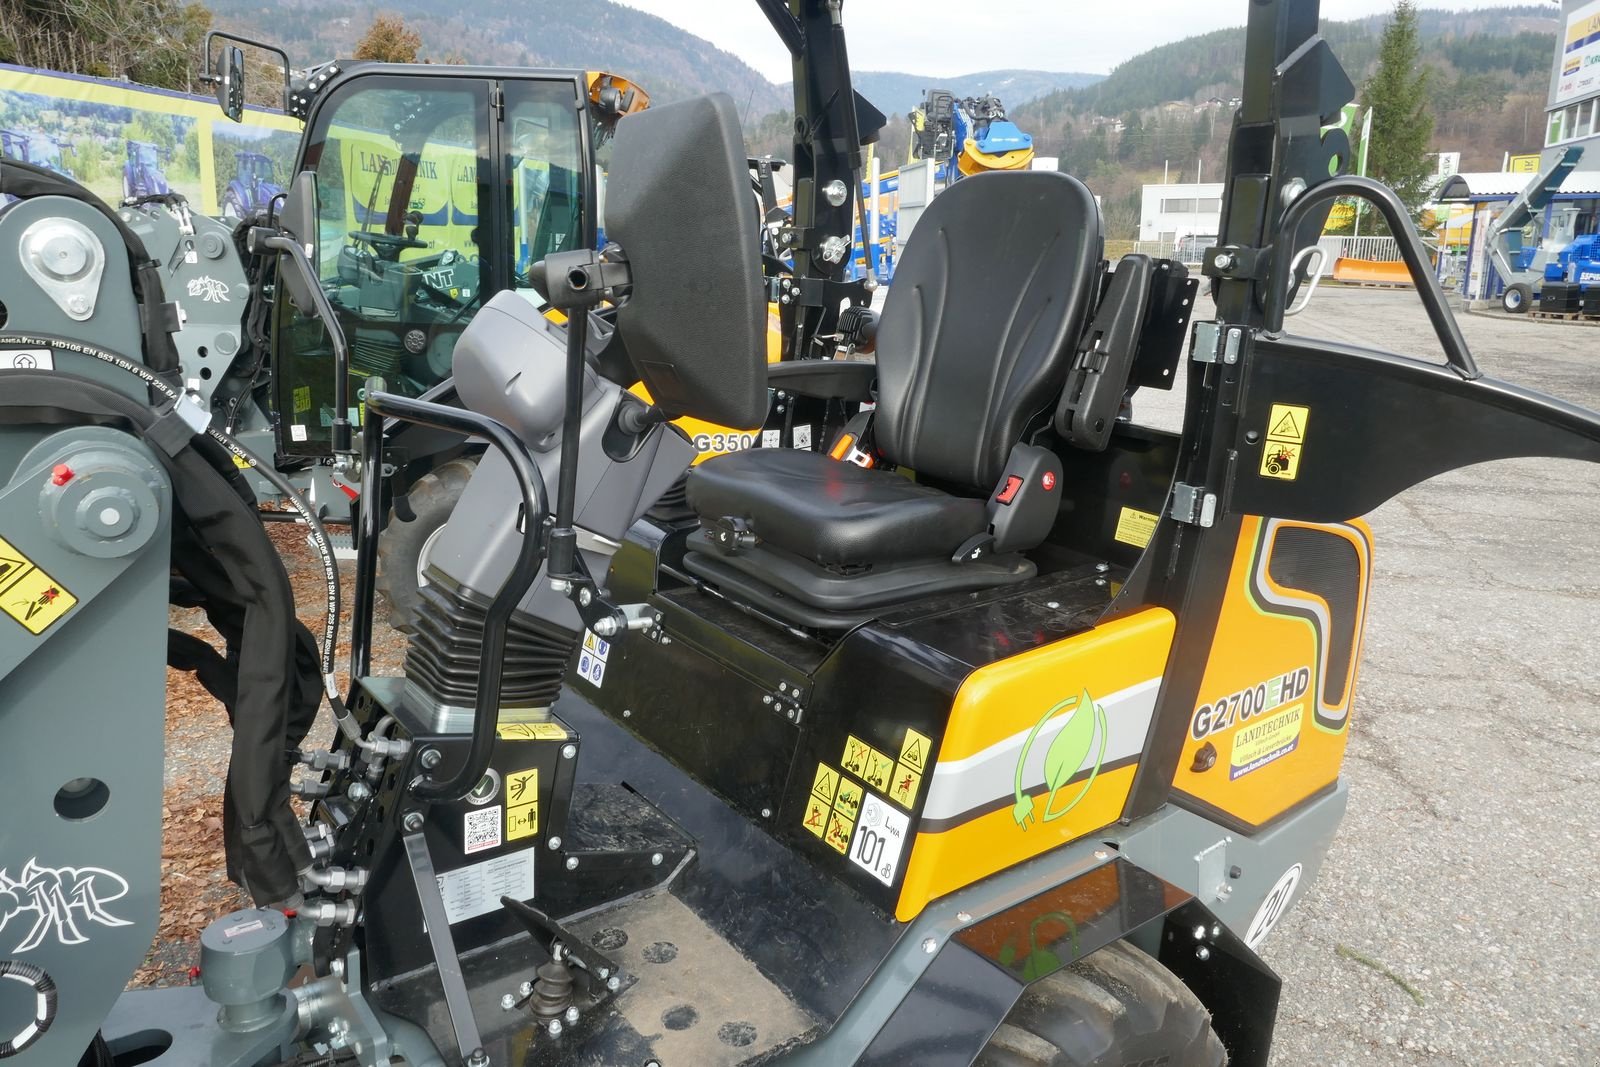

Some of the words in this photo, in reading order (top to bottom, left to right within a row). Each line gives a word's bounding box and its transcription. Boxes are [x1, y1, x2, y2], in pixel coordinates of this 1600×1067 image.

[51, 340, 81, 352] HD106
[83, 347, 97, 356] EN
[97, 351, 114, 362] 853
[115, 358, 133, 371] 1SN
[139, 370, 153, 381] WP
[152, 379, 168, 392] 225
[165, 389, 177, 400] BA
[693, 434, 757, 453] G350
[314, 532, 328, 555] HD106
[323, 555, 332, 567] EN
[325, 567, 334, 580] 853
[328, 581, 336, 595] 1SN
[328, 601, 336, 613] WP
[327, 613, 335, 625] 225
[325, 625, 334, 639] BAR
[1192, 667, 1309, 740] G2700EHD
[1236, 708, 1301, 748] LANDTECHNIK
[856, 825, 887, 871] 101
[1250, 876, 1294, 944] 20
